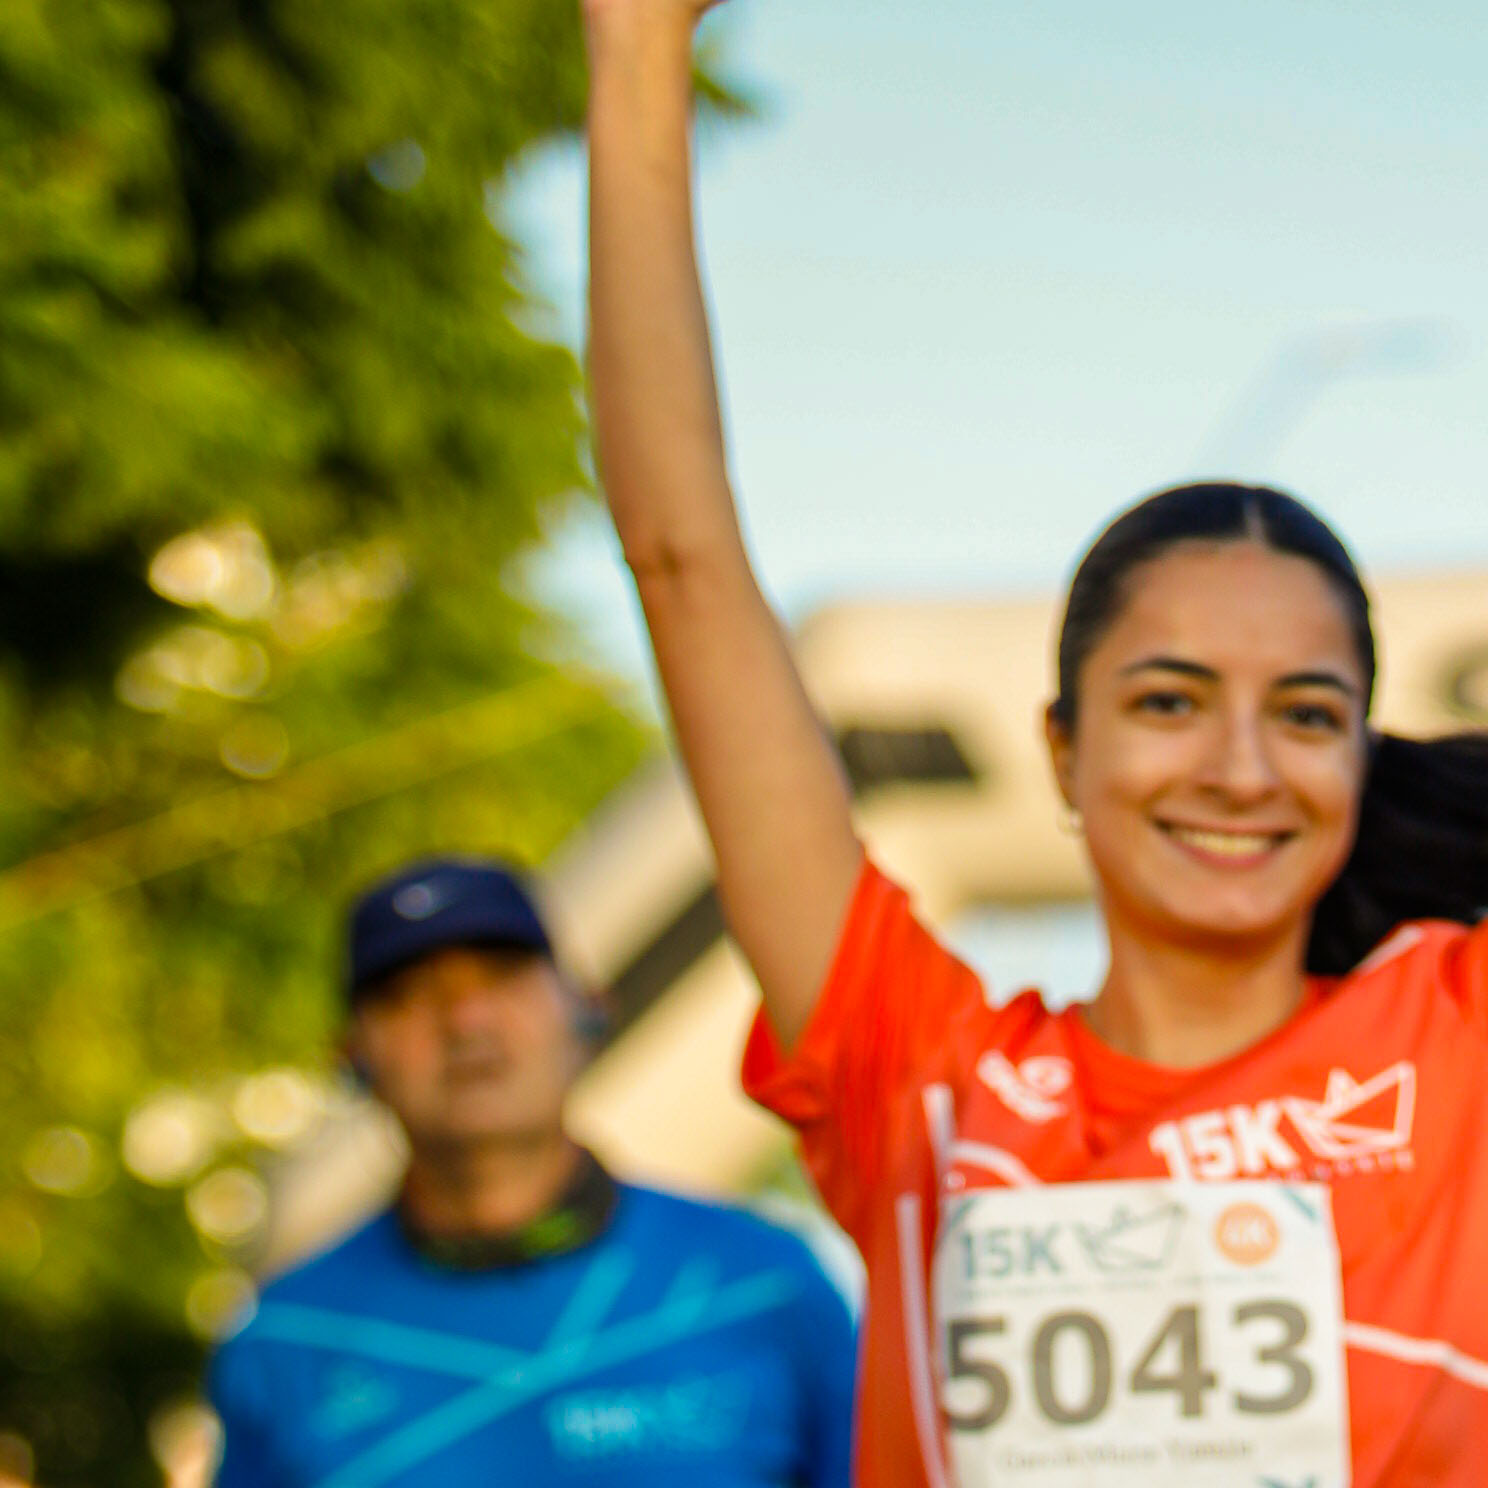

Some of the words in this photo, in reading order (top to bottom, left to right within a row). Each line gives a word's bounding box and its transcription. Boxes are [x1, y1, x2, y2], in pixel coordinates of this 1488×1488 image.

[1148, 1097, 1299, 1181] 15K
[962, 1222, 1062, 1280] 15K
[946, 1299, 1316, 1434] 5043
